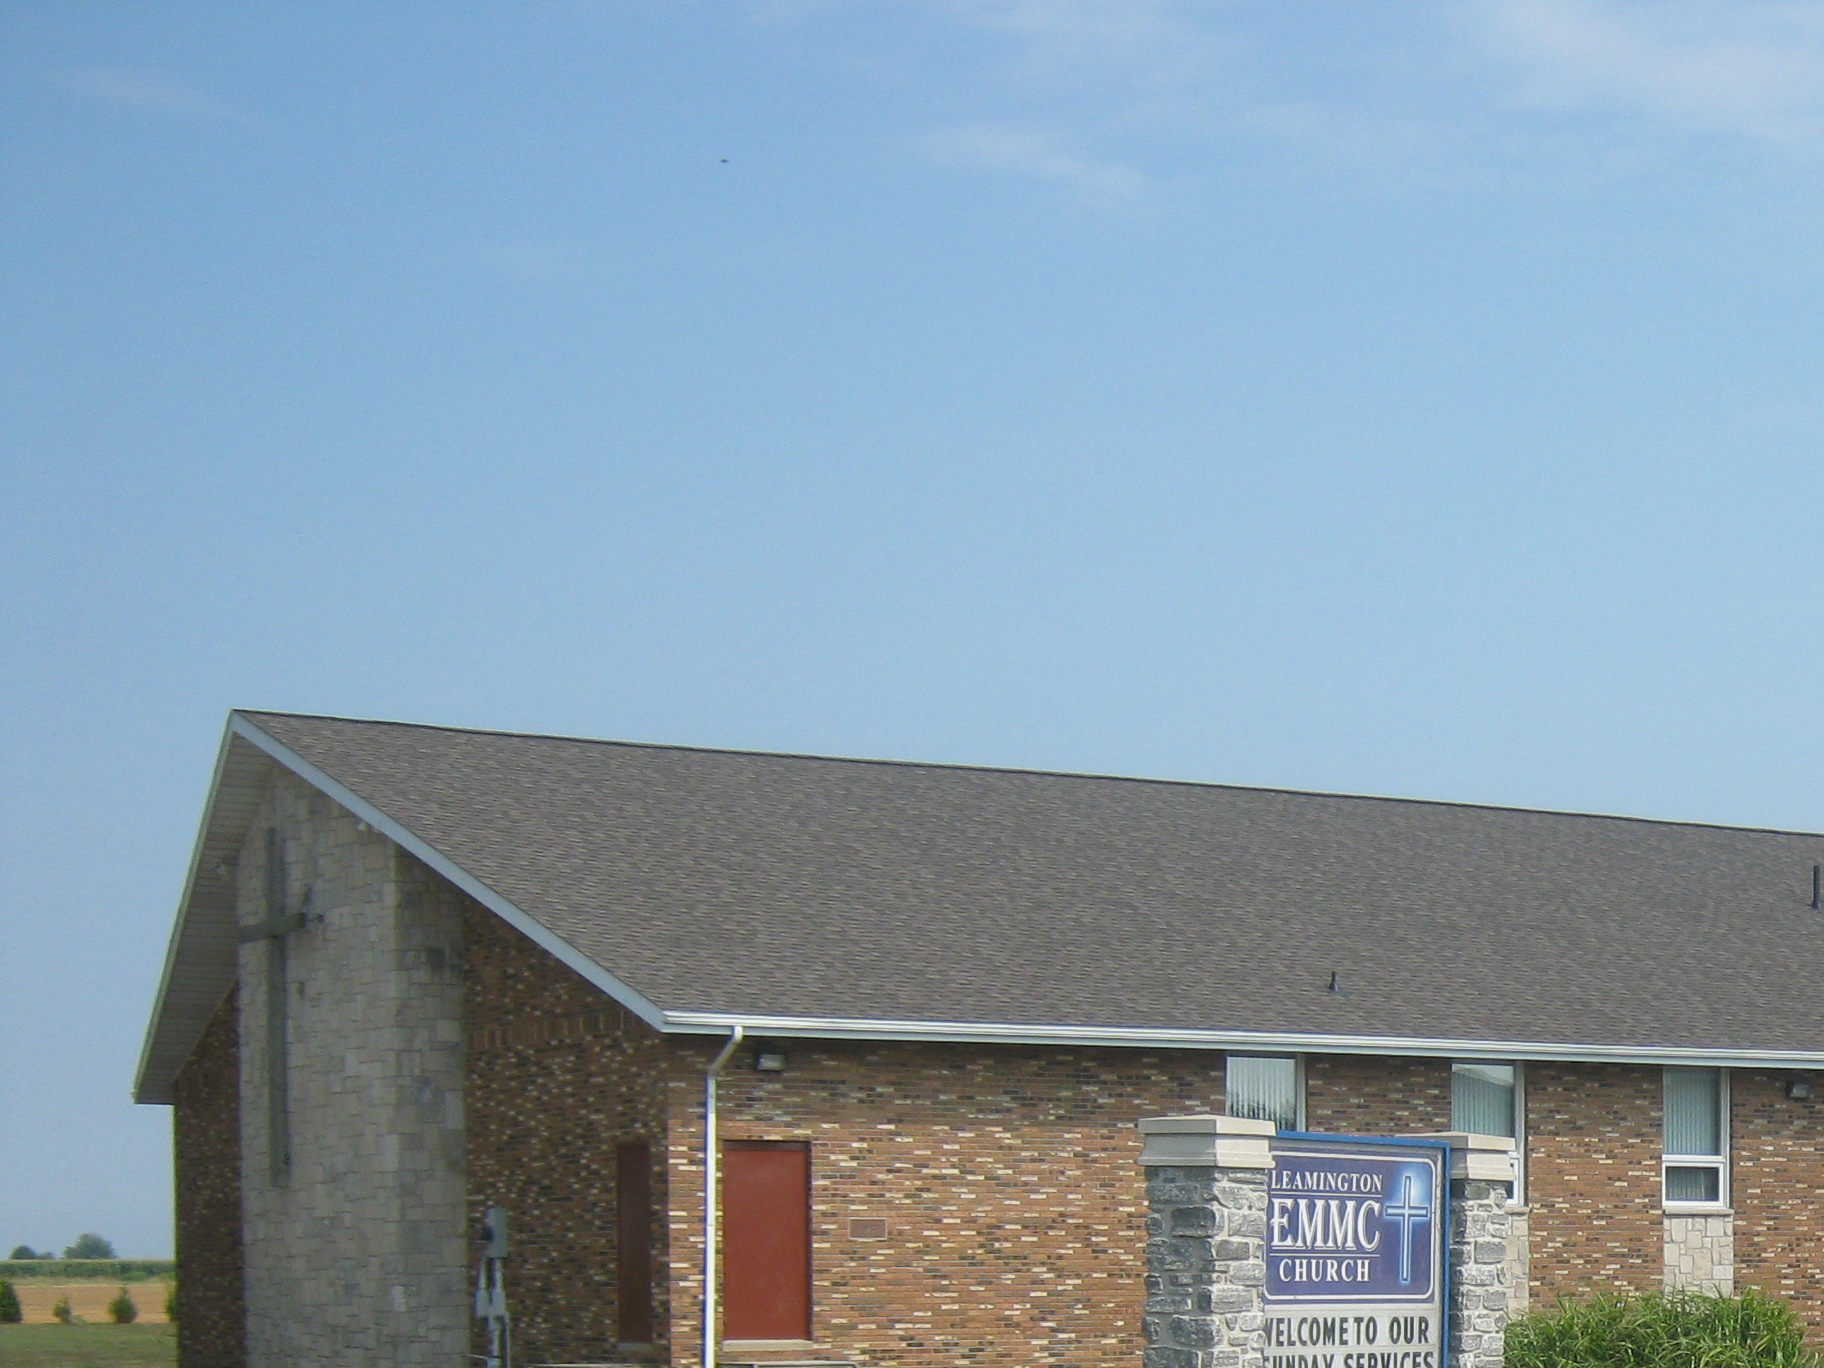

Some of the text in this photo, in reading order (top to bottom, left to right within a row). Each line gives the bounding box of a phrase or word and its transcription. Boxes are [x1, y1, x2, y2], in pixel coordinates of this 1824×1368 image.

[1270, 1170, 1382, 1192] LEAMINGTON
[1270, 1198, 1381, 1251] EMMC
[1279, 1259, 1370, 1282] CHURCH
[1353, 1316, 1378, 1346] TO
[1389, 1316, 1429, 1344] OUR
